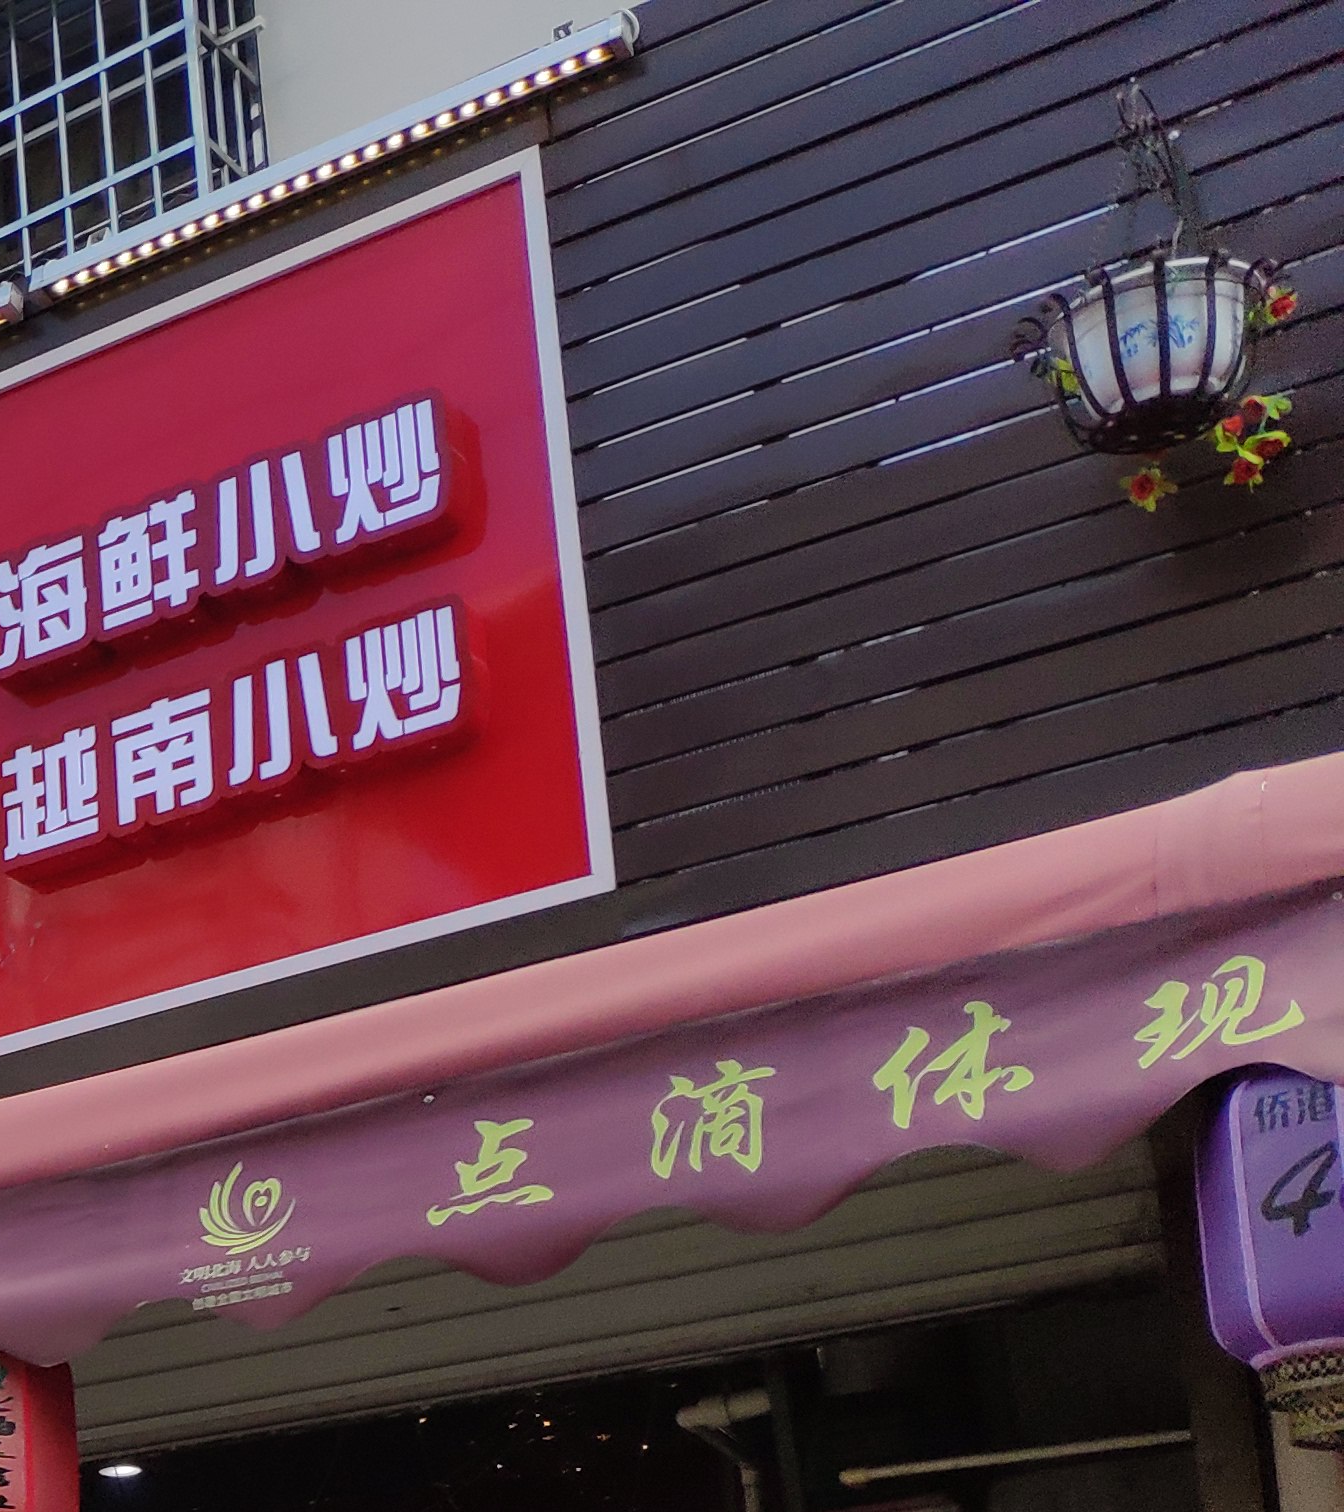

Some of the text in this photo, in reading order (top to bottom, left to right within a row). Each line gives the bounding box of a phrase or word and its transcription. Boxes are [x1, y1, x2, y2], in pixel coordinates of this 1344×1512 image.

[2, 605, 463, 862] 越南小炒
[427, 954, 1306, 1228] 点滴体现
